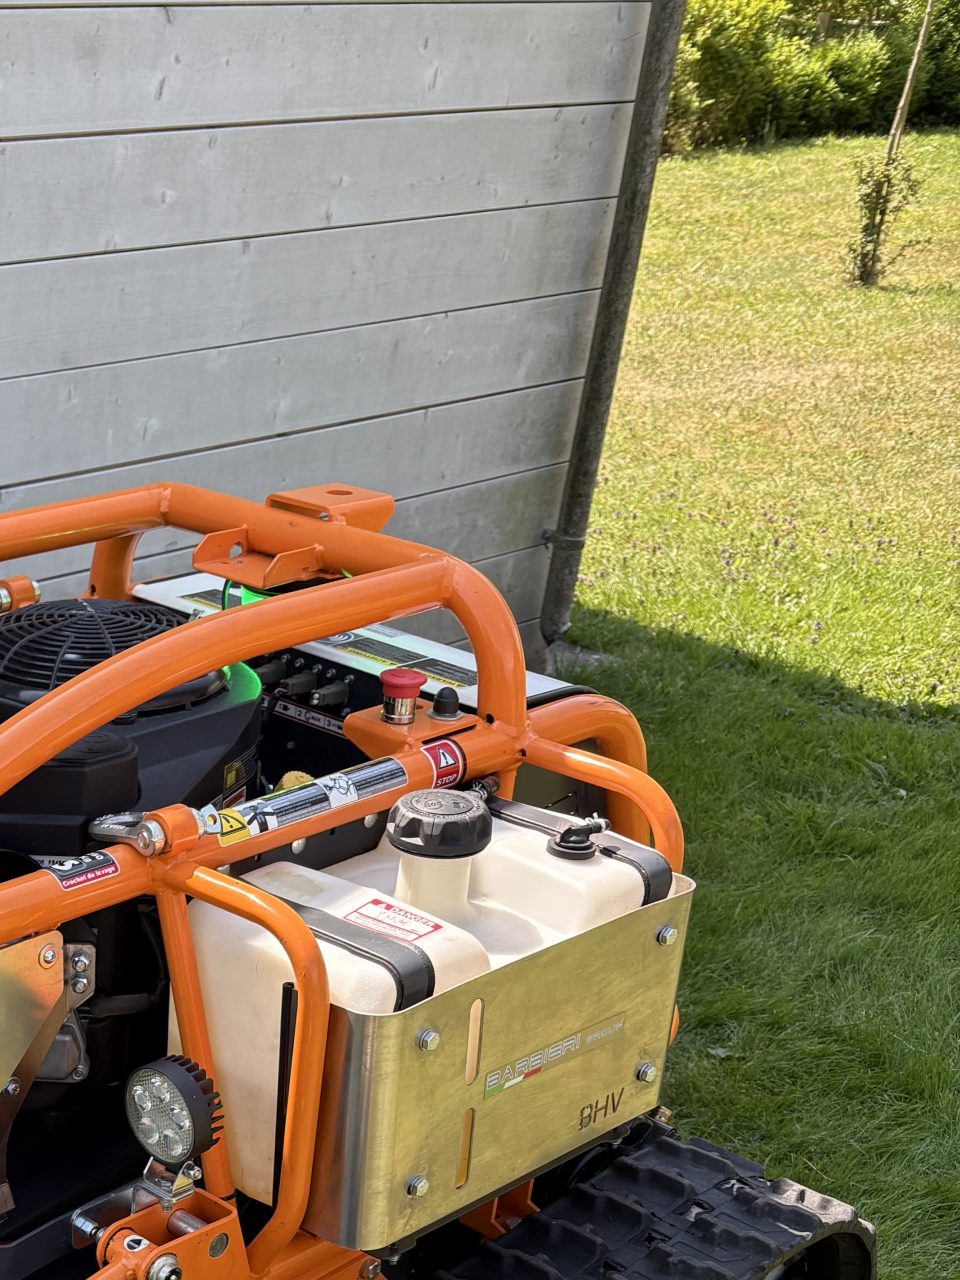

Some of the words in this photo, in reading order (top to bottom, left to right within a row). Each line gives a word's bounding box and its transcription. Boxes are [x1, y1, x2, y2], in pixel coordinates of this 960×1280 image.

[437, 773, 457, 787] STOP
[62, 874, 86, 887] Crochet
[95, 865, 117, 877] levage
[389, 905, 434, 928] DANGER
[486, 1034, 581, 1091] BARBIERI
[578, 1087, 625, 1131] BHV
